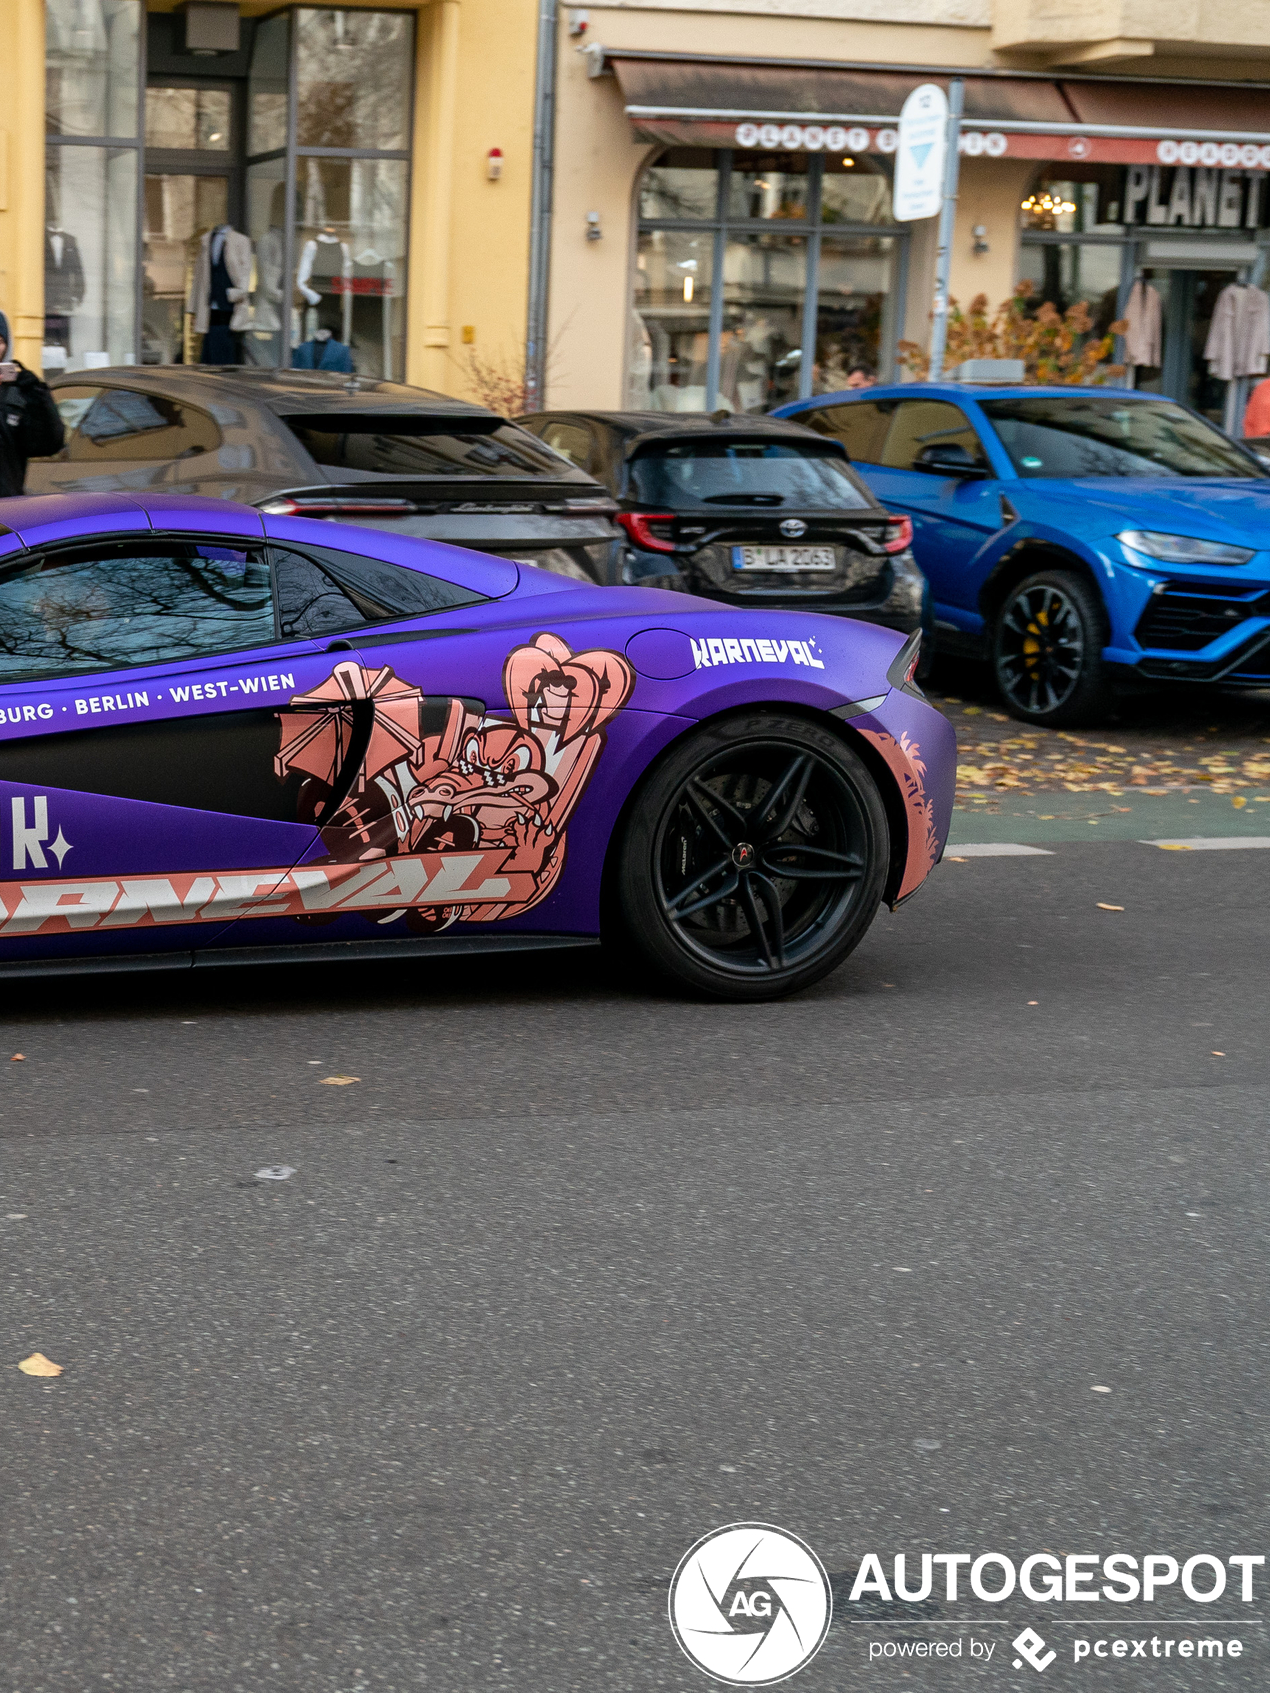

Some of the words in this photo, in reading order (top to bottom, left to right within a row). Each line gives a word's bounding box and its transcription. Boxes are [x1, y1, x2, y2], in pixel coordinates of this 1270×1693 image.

[1124, 165, 1267, 228] PLANET
[744, 548, 755, 566] B
[690, 637, 825, 670] KARNEVAL
[74, 691, 150, 715] BERLIN
[169, 672, 296, 703] WEST-WIEN
